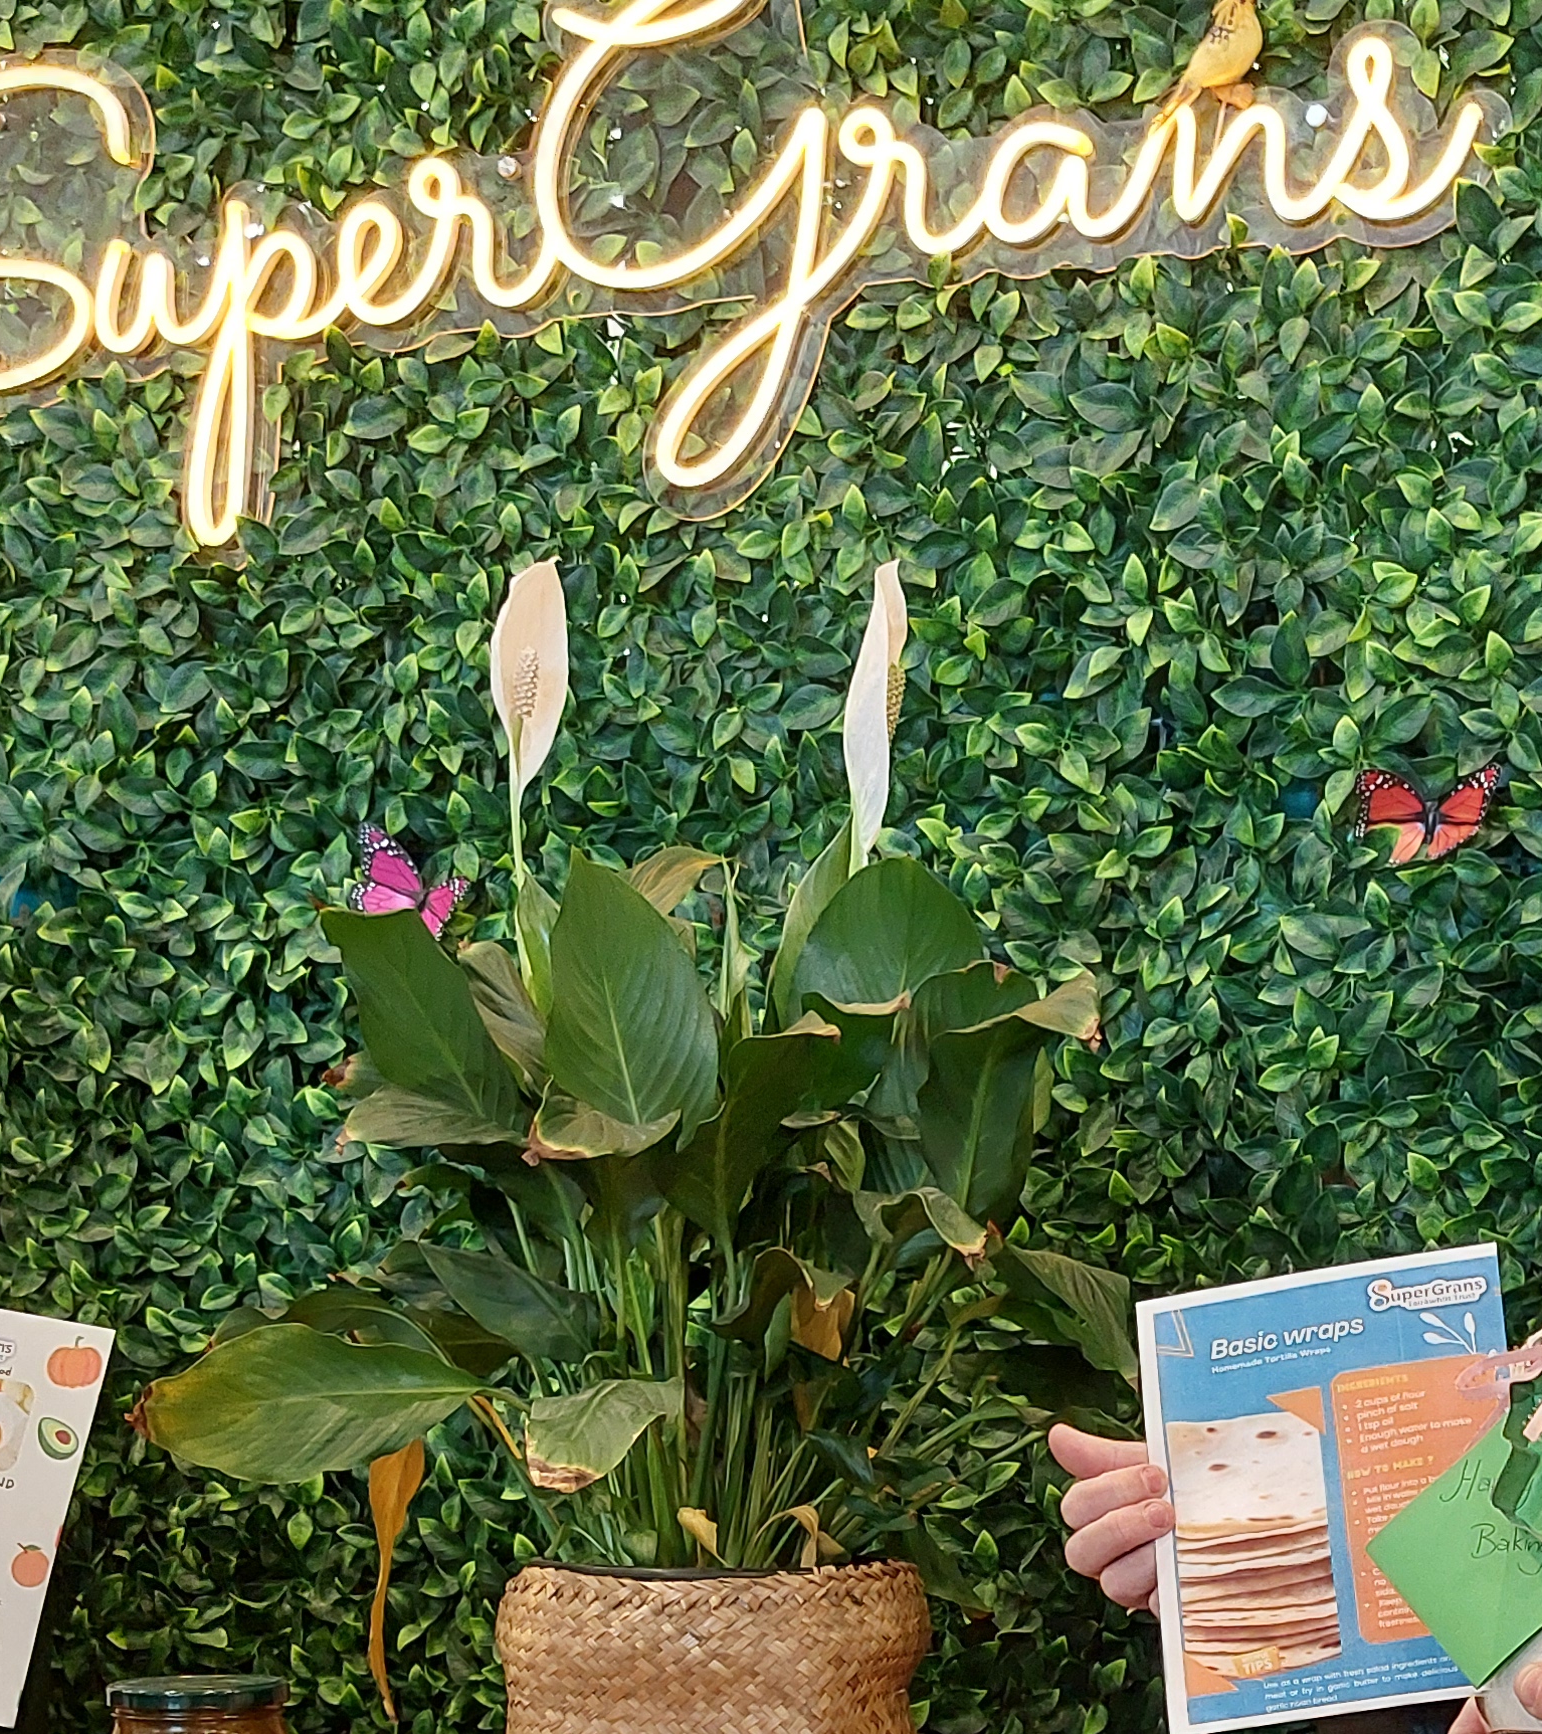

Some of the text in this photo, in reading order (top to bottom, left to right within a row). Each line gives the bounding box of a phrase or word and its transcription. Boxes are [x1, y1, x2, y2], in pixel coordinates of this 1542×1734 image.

[1371, 1277, 1484, 1307] SuperGrans
[1210, 1317, 1365, 1361] Basic wraps
[1211, 1346, 1332, 1375] Homemade Tortilla Wraps
[1356, 1407, 1386, 1423] pinch
[1243, 1658, 1273, 1676] TIPS
